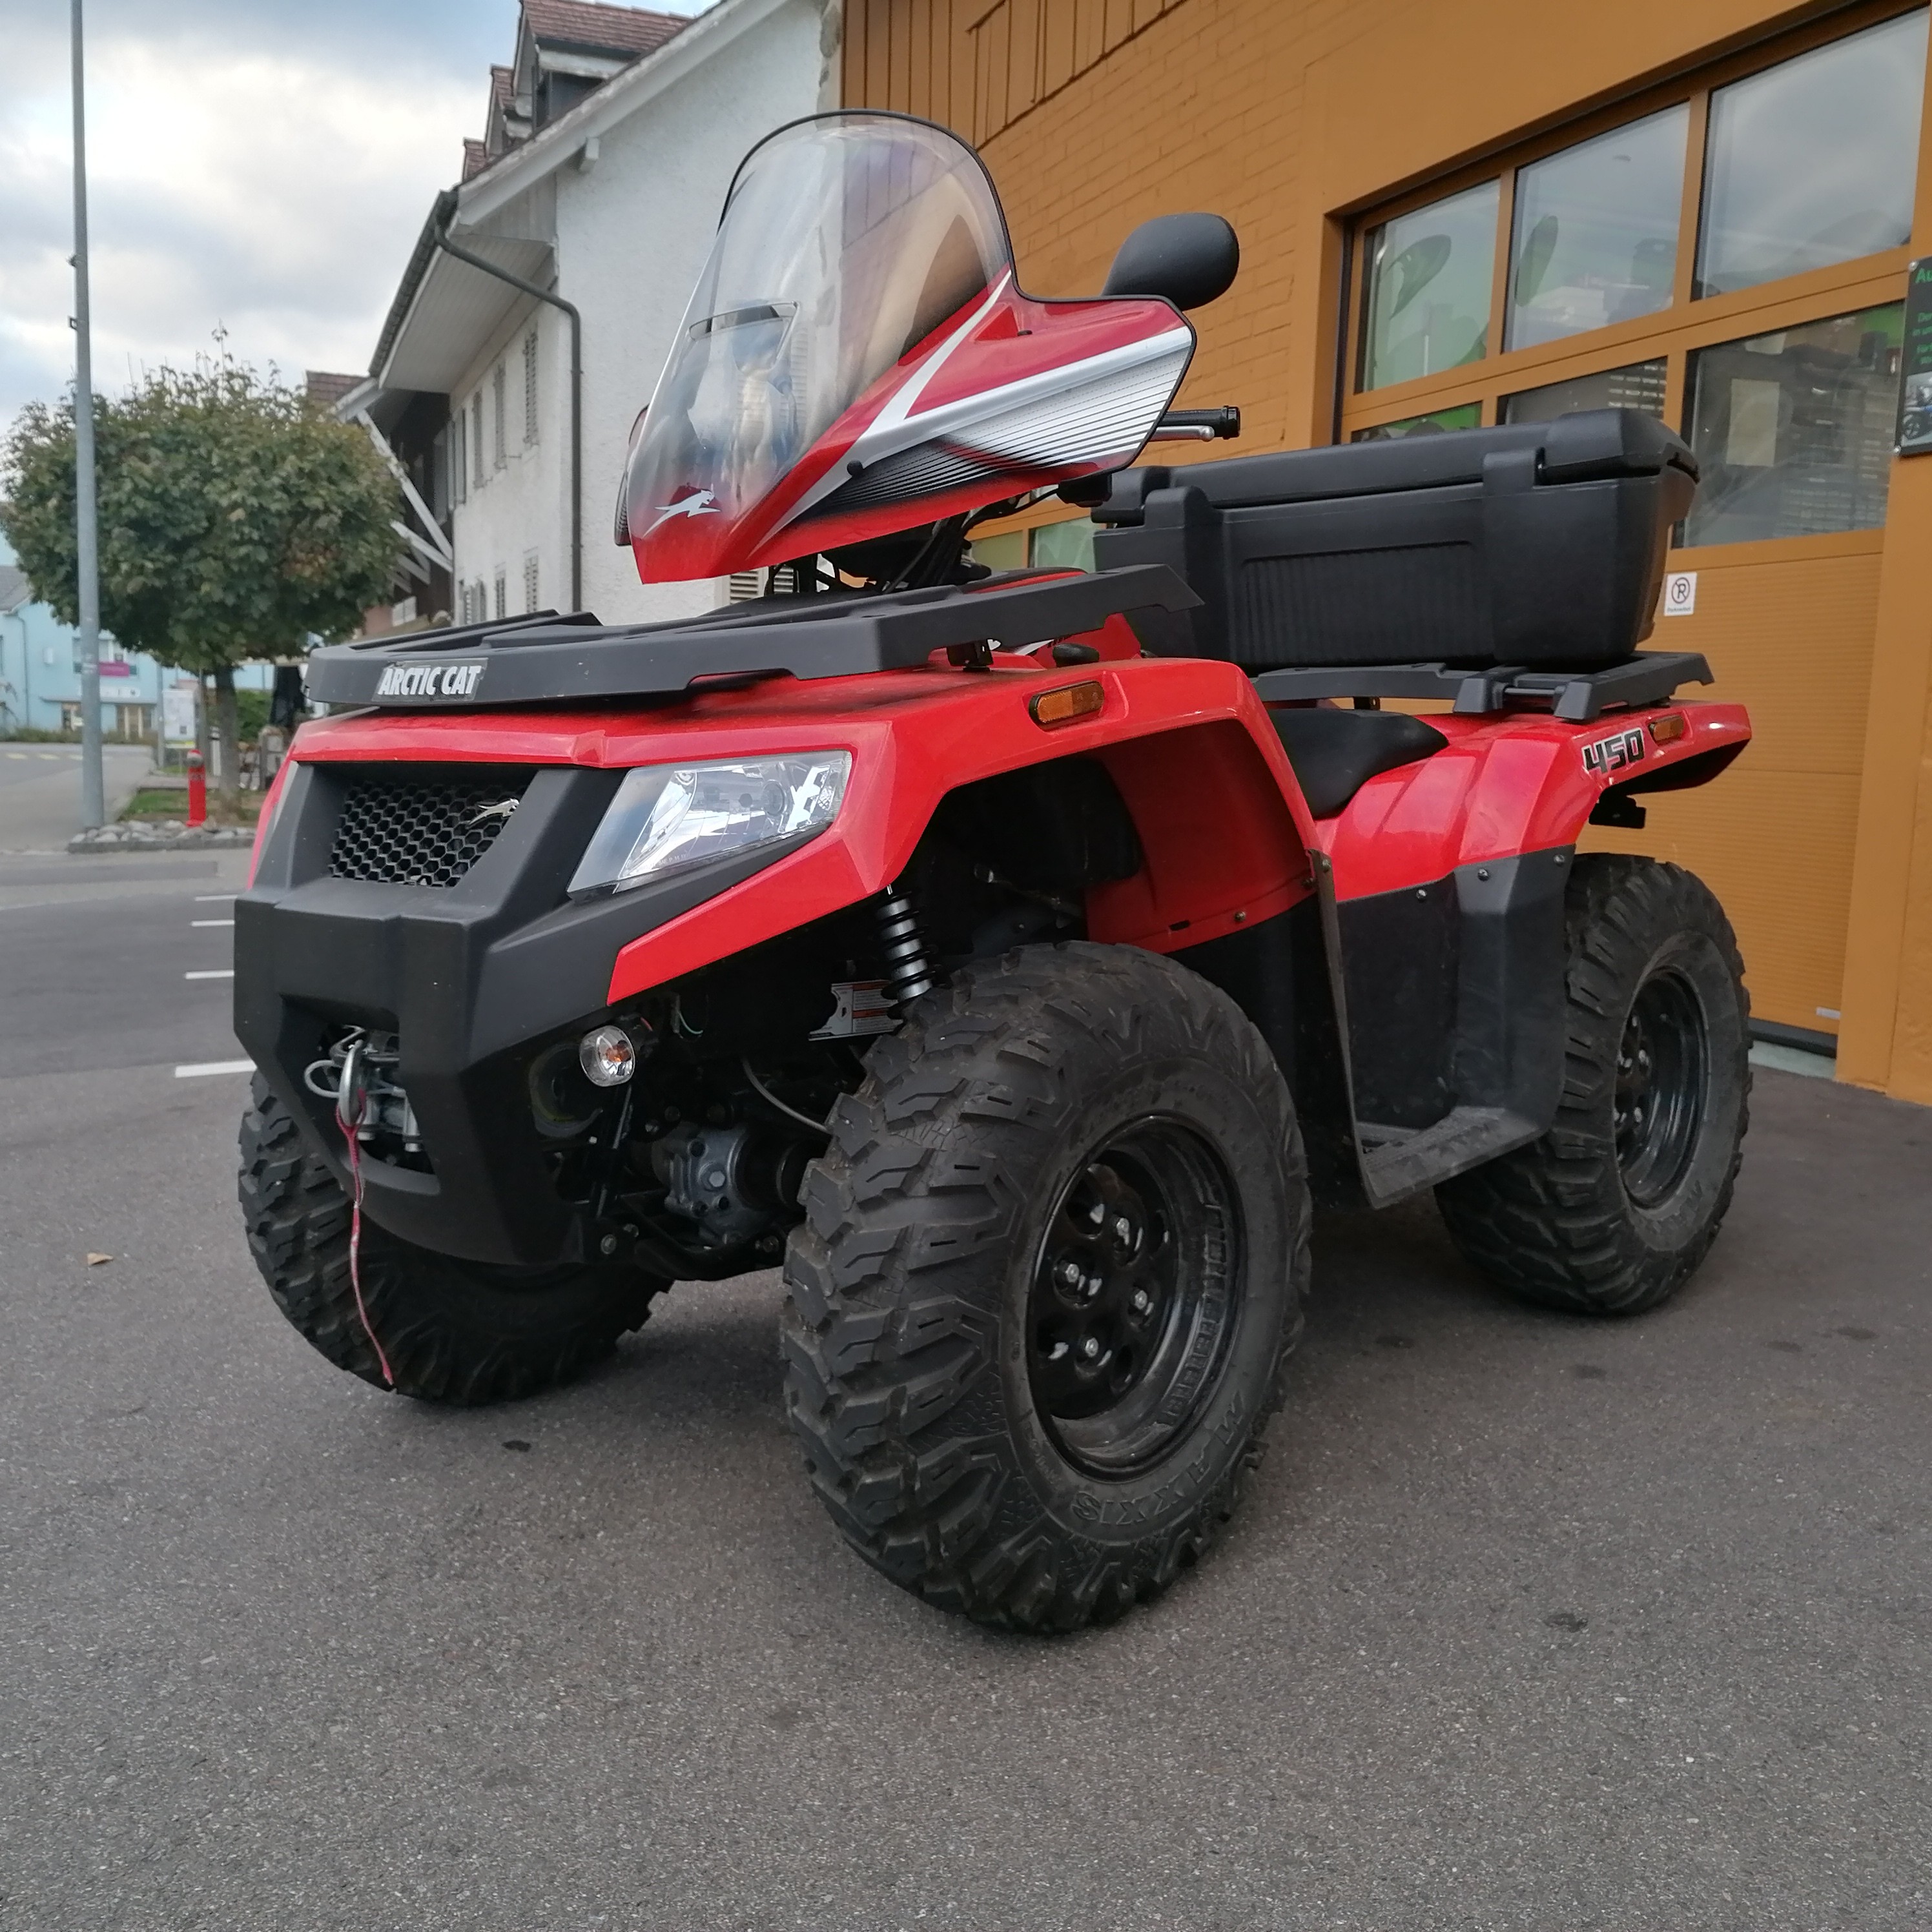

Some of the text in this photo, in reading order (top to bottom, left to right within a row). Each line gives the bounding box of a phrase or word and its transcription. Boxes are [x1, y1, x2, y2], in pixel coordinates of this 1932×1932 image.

[378, 666, 482, 695] ARCTIC CAT
[1581, 728, 1645, 773] 450
[1071, 1390, 1244, 1525] MAXXIS
